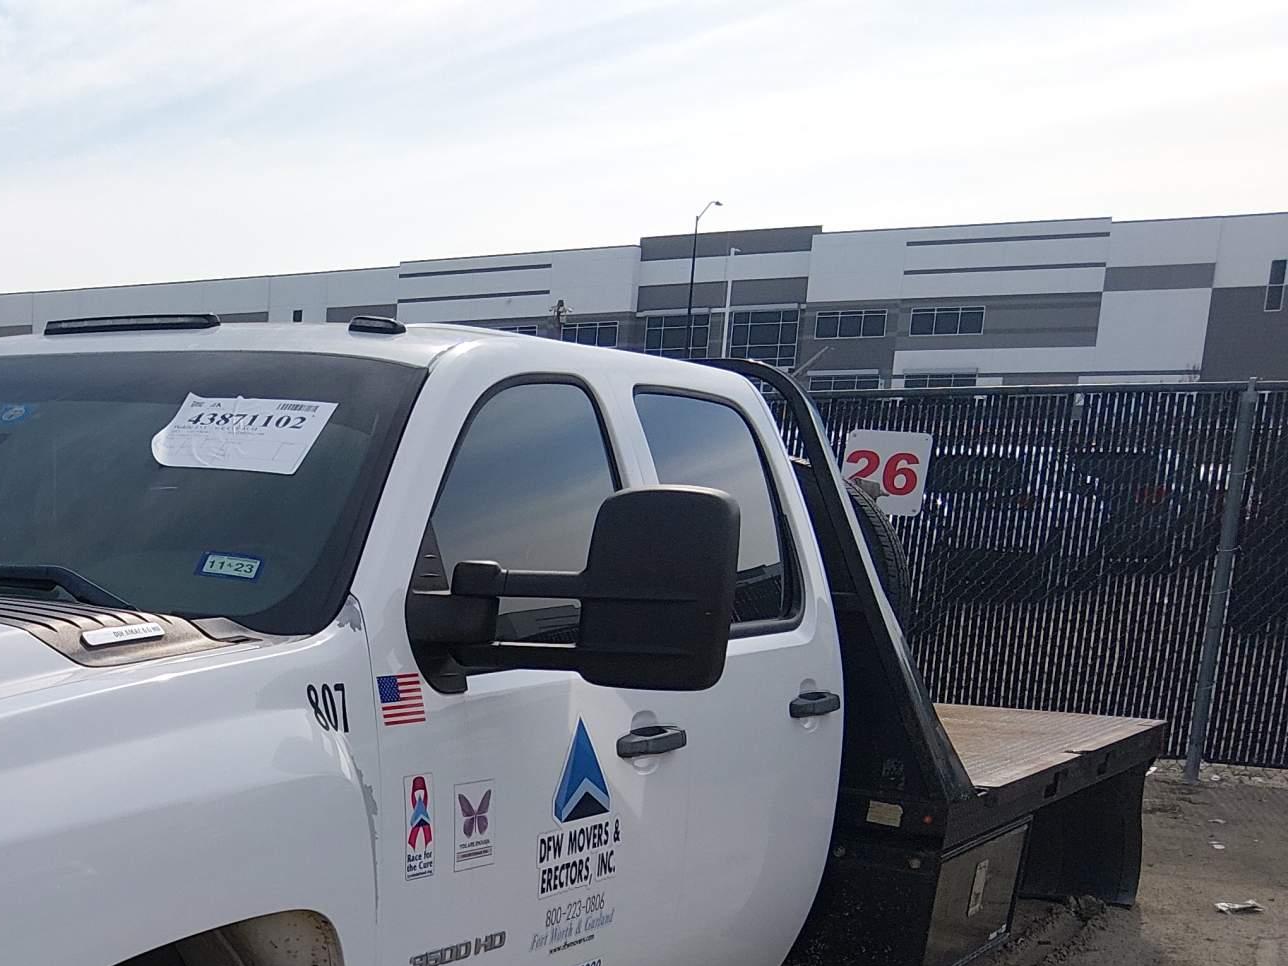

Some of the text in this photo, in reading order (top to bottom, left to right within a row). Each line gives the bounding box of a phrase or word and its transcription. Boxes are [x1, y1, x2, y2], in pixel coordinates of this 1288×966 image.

[187, 412, 307, 430] 43871102
[845, 450, 920, 496] 26
[307, 683, 349, 733] 807
[539, 818, 621, 864] DFW MOVERS &
[407, 851, 432, 863] Race for
[407, 861, 433, 873] the Cure
[540, 849, 616, 895] ERECTORS, INC.
[545, 892, 605, 928] 800-223-0806
[584, 906, 616, 931] Garland
[474, 931, 506, 956] HD
